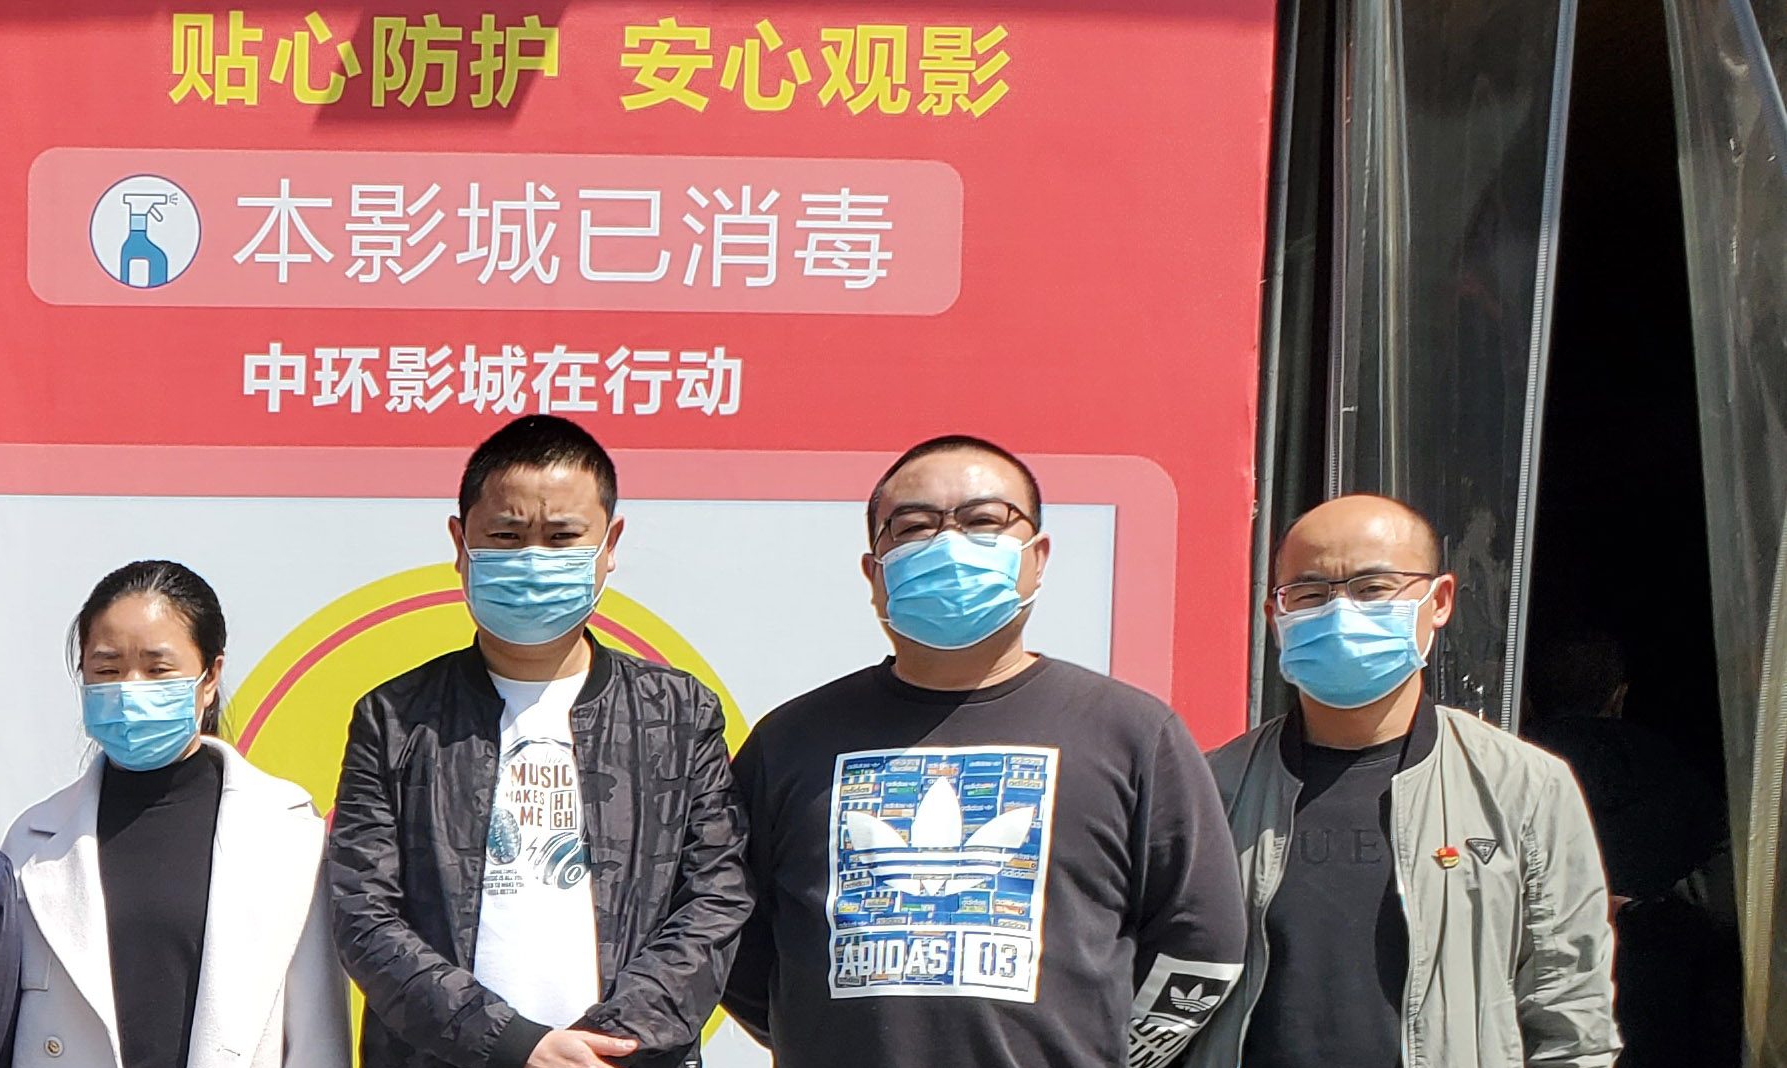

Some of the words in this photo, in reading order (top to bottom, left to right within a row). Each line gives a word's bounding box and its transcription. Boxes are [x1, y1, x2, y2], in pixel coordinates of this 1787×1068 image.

[169, 12, 560, 109] 贴心防护
[618, 20, 1010, 118] 安心观影
[232, 178, 895, 291] 本影城已消毒
[242, 342, 743, 416] 中环影城在行动
[511, 763, 573, 789] MUSIC
[519, 806, 543, 827] ME
[840, 938, 949, 977] ADIDAS
[980, 941, 1017, 977] 03
